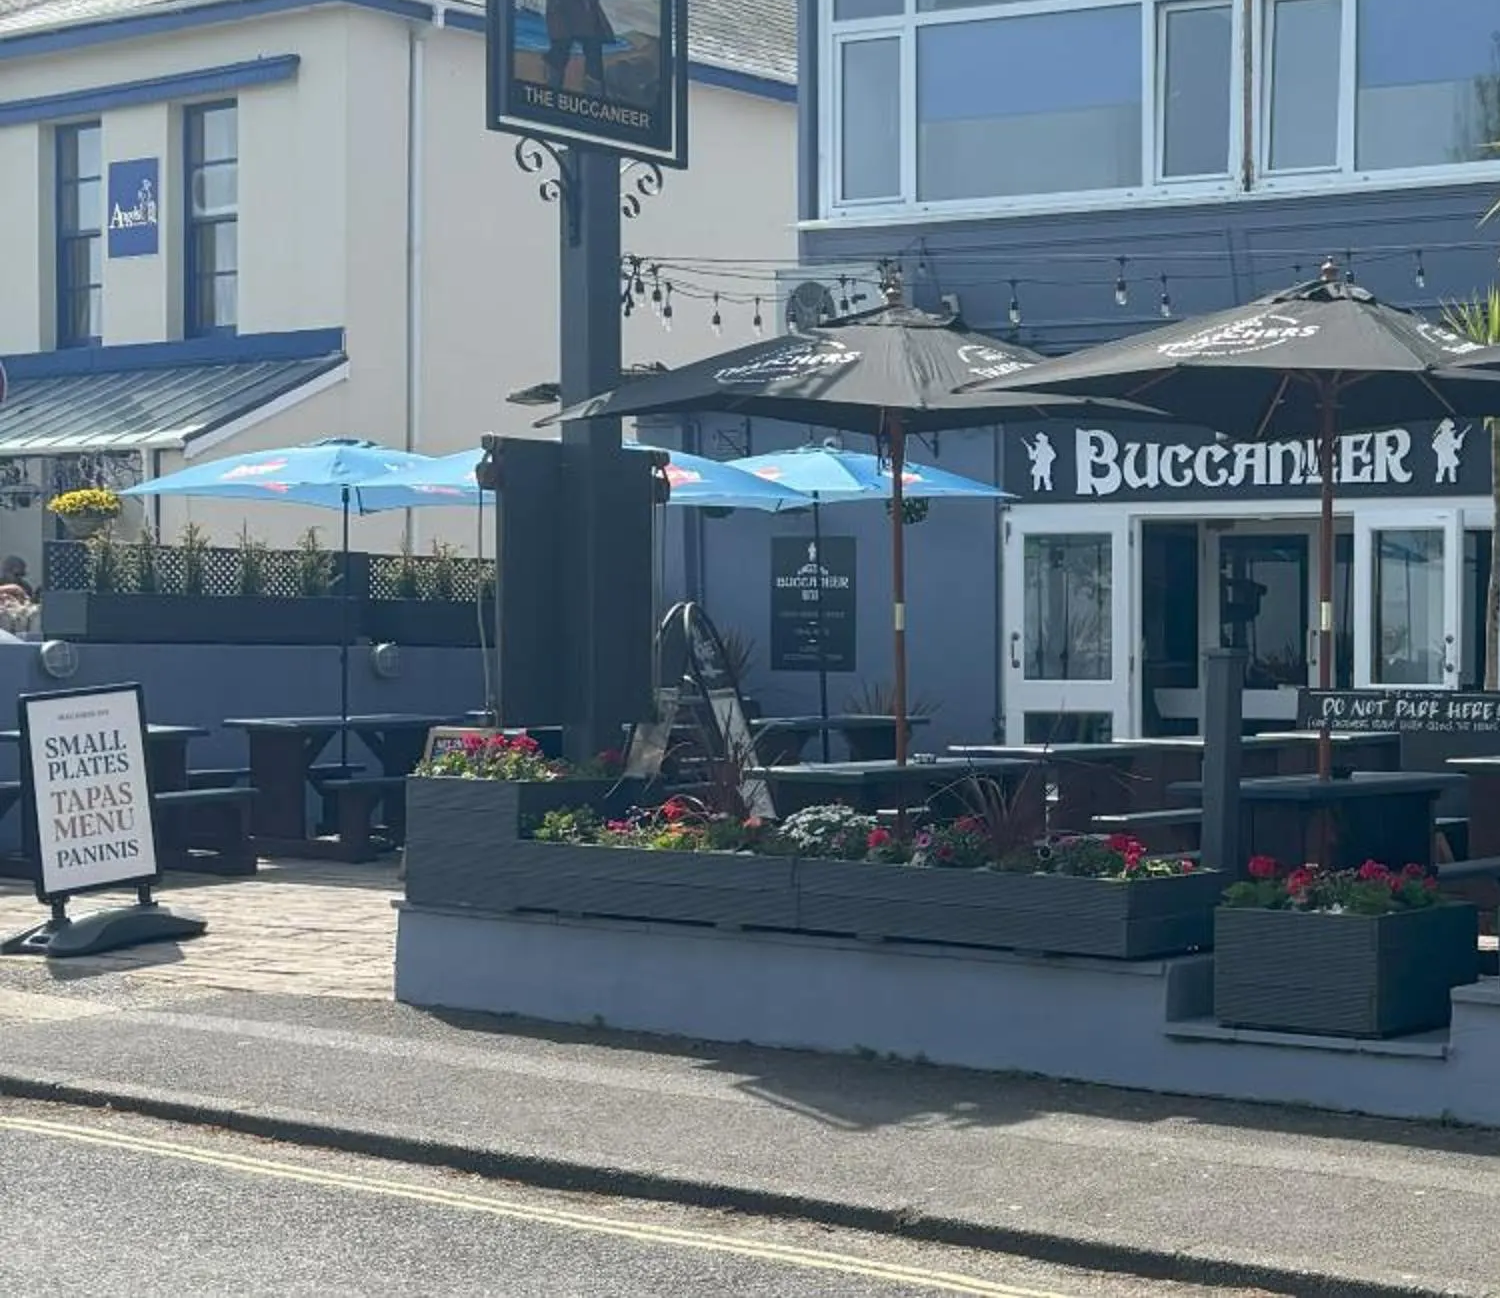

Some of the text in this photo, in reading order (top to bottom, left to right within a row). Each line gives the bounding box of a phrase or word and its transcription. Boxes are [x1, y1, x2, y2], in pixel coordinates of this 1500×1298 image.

[523, 84, 650, 129] THE BUCCANEER
[1075, 428, 1413, 497] BUCCANEER
[1322, 697, 1346, 716] DO
[1350, 698, 1390, 717] NOT
[1396, 698, 1441, 719] PARK
[45, 729, 127, 760] SMALL
[48, 753, 130, 782] PLATES
[50, 782, 133, 815] TAPAS
[53, 808, 135, 842] MENU
[56, 839, 140, 869] PANINIS
